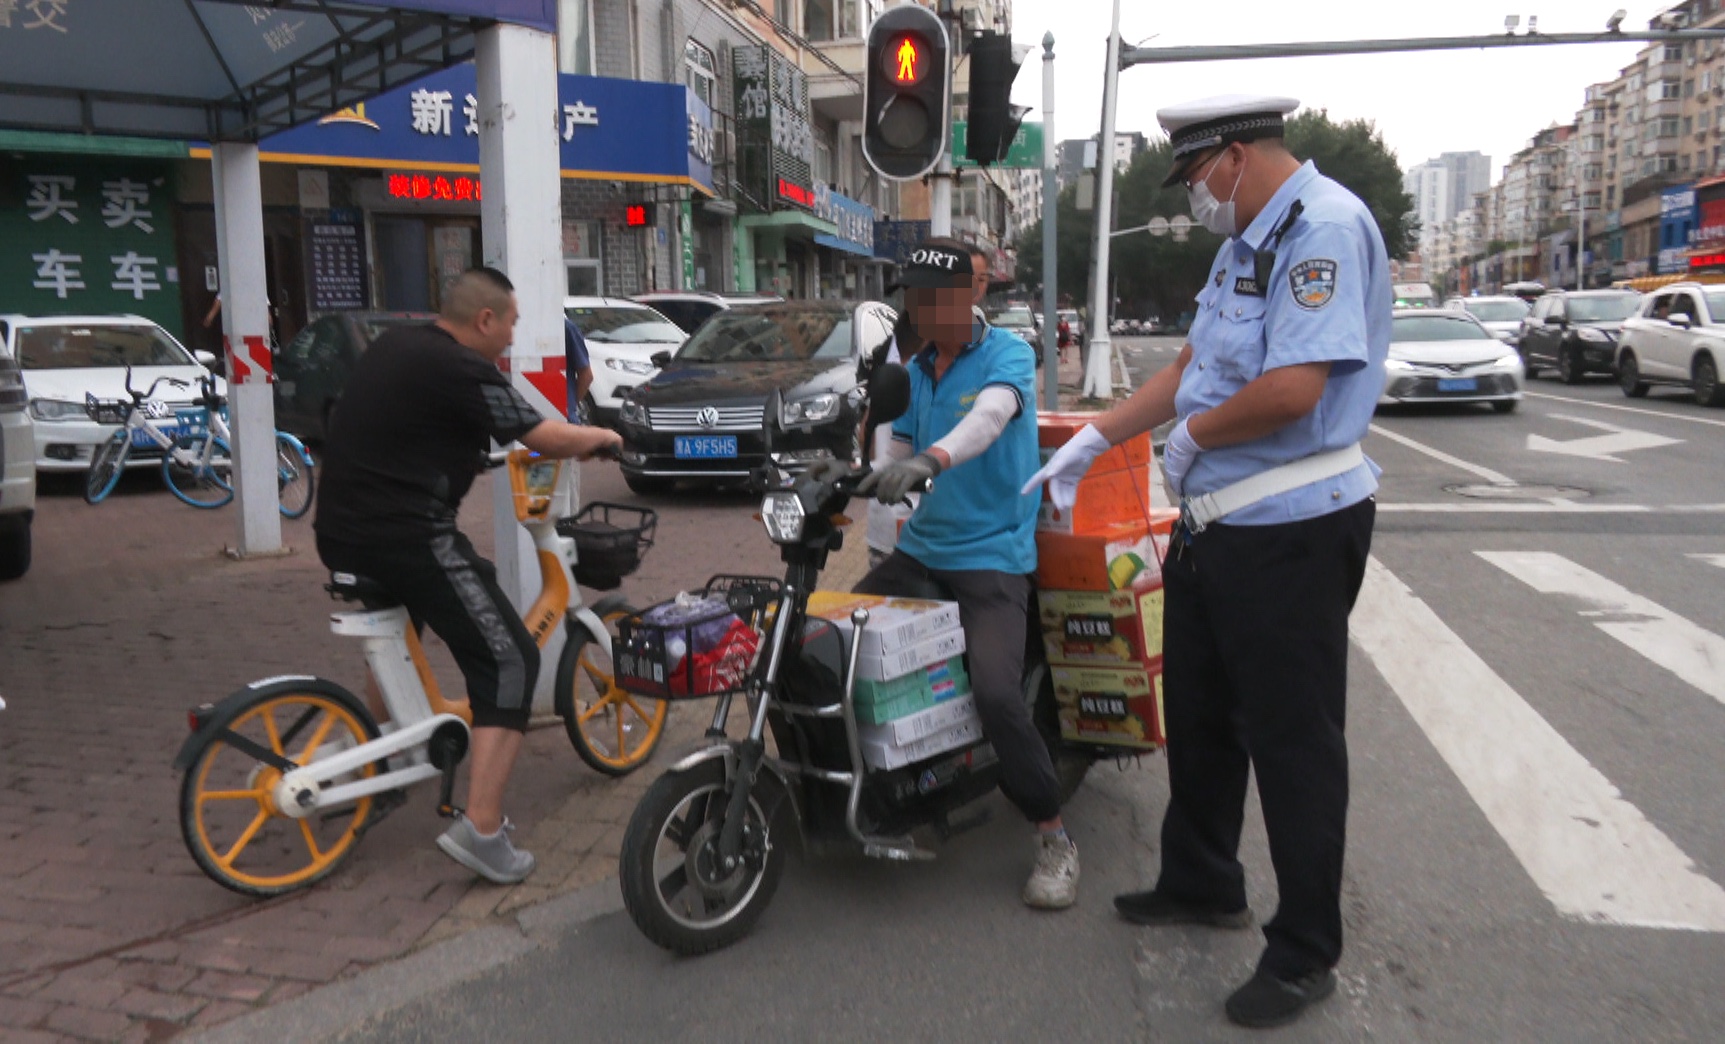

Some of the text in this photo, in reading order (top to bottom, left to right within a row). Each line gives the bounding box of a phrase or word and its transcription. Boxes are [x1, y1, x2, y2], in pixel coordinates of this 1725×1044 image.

[388, 173, 482, 200] 装修免费
[911, 249, 959, 270] ORT
